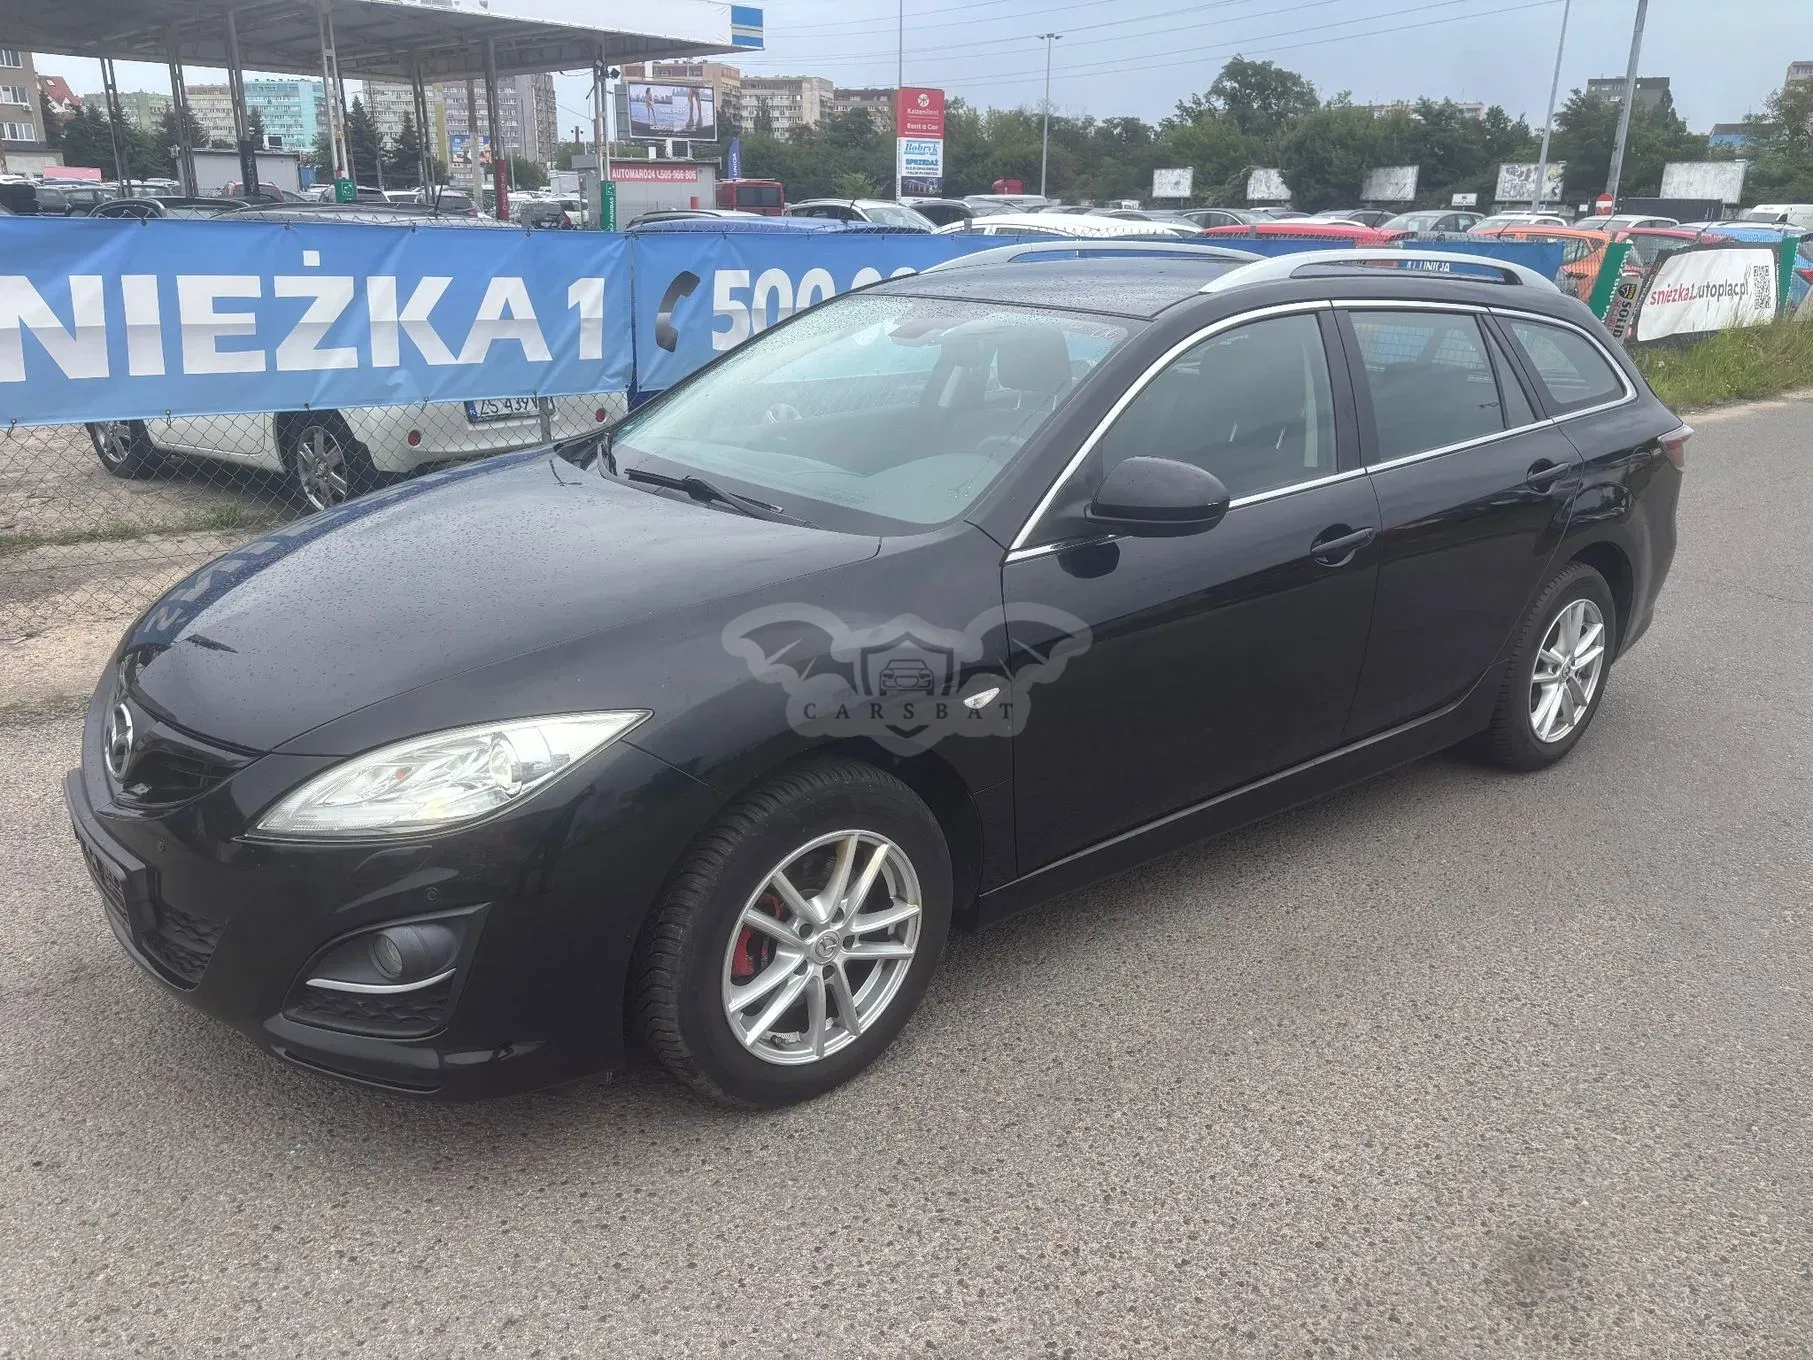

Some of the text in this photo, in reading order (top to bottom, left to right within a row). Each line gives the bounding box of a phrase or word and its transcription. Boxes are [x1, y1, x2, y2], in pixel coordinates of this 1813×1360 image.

[907, 122, 921, 130] Rent
[927, 123, 939, 131] Car
[567, 277, 605, 360] 1
